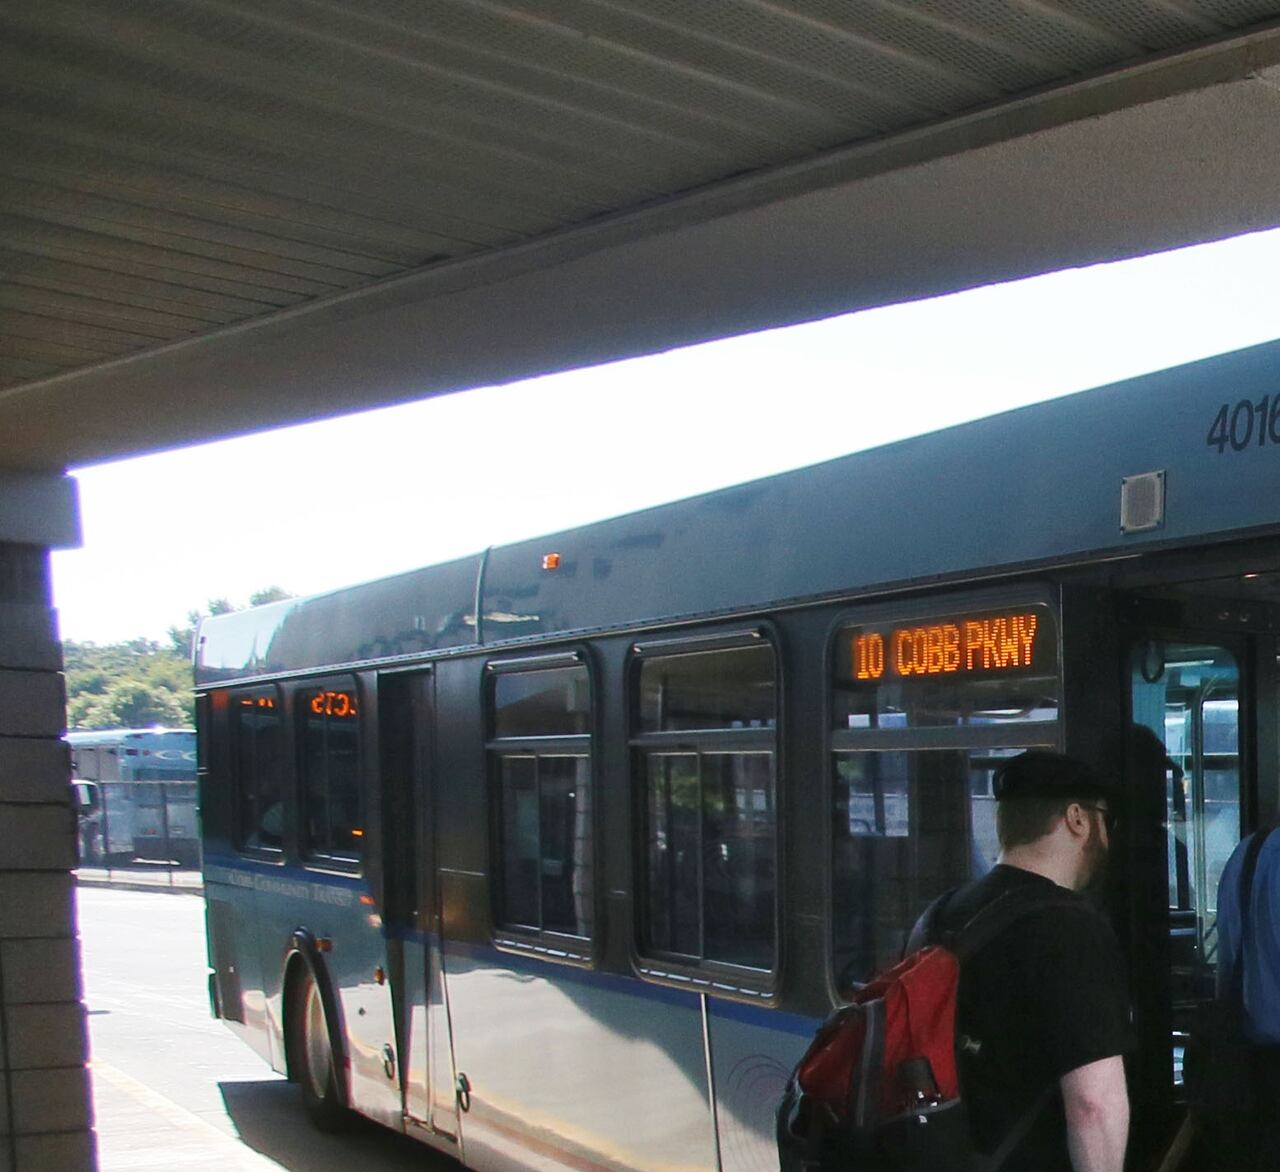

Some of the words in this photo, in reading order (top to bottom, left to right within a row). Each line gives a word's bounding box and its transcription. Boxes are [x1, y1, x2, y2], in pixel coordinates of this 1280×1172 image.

[856, 632, 885, 680] 10
[896, 623, 961, 676] COBB
[965, 614, 1037, 670] PKWY
